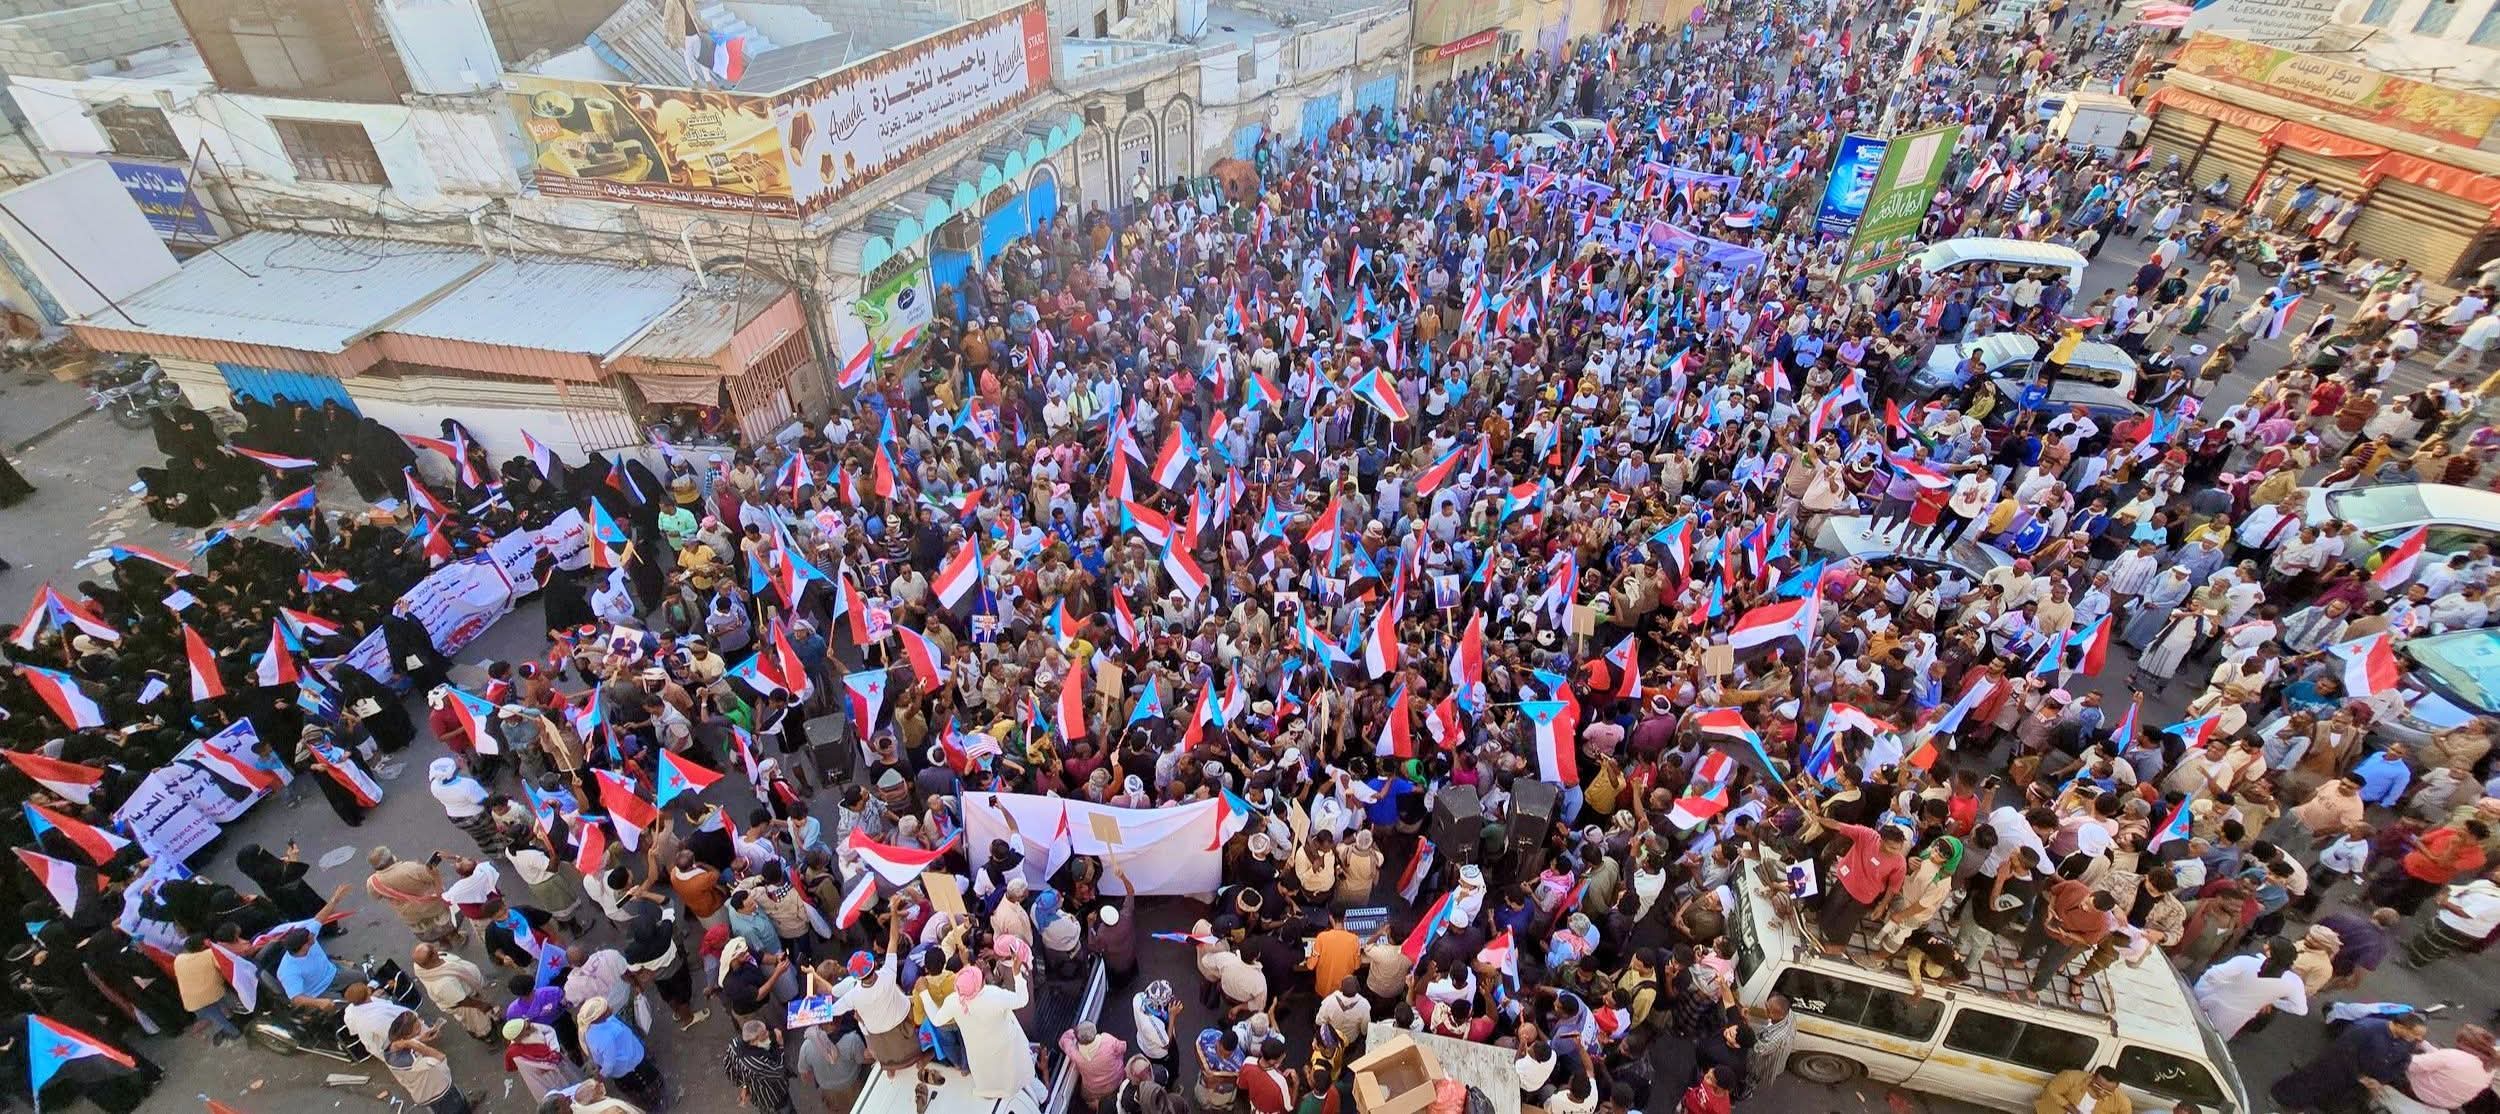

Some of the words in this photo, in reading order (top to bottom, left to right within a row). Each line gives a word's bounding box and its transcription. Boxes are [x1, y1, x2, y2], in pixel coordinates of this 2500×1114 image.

[2279, 10, 2302, 21] FOR
[1027, 32, 1045, 49] STARZ
[937, 48, 986, 84] باحميد
[991, 36, 1024, 87] Amada
[2289, 58, 2329, 79] الميناء
[2326, 66, 2362, 86] مركز
[871, 67, 933, 115] للتجارة
[827, 95, 867, 144] Amada
